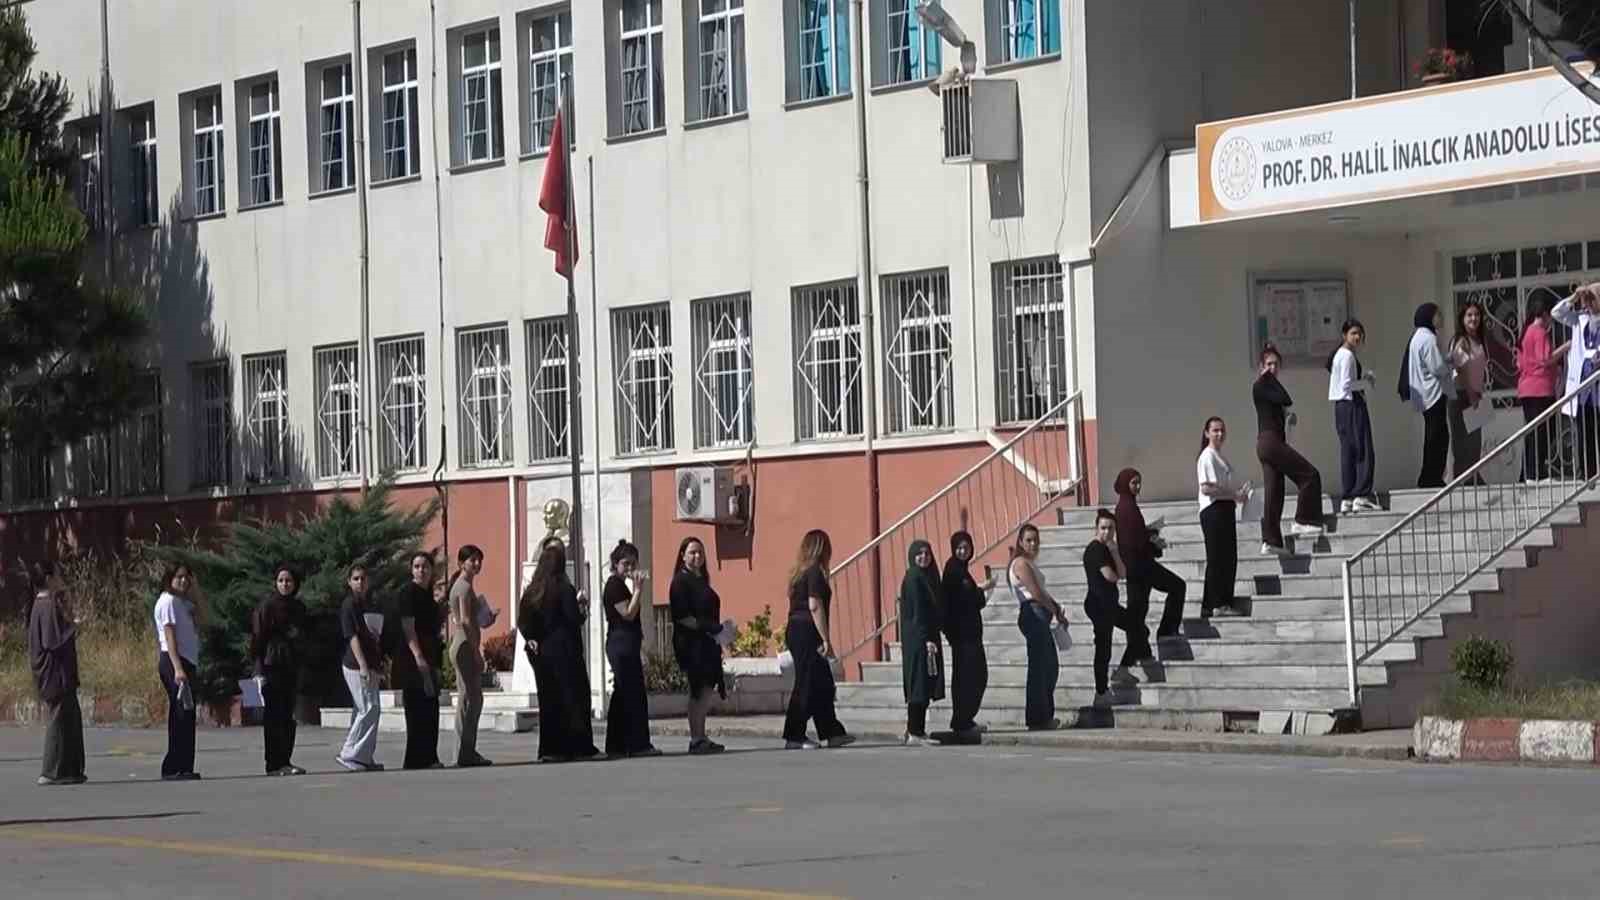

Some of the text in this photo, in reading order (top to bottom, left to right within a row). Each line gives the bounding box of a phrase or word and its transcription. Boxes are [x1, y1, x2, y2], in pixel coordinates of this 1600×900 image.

[1262, 139, 1294, 152] YALOVA
[1300, 130, 1334, 147] MERKEZ
[1263, 159, 1307, 189] PROF.
[1311, 155, 1338, 182] DR.
[1341, 141, 1389, 178] HALİL
[1393, 139, 1459, 171] İNALCIK
[1463, 121, 1550, 161] ANADOLU
